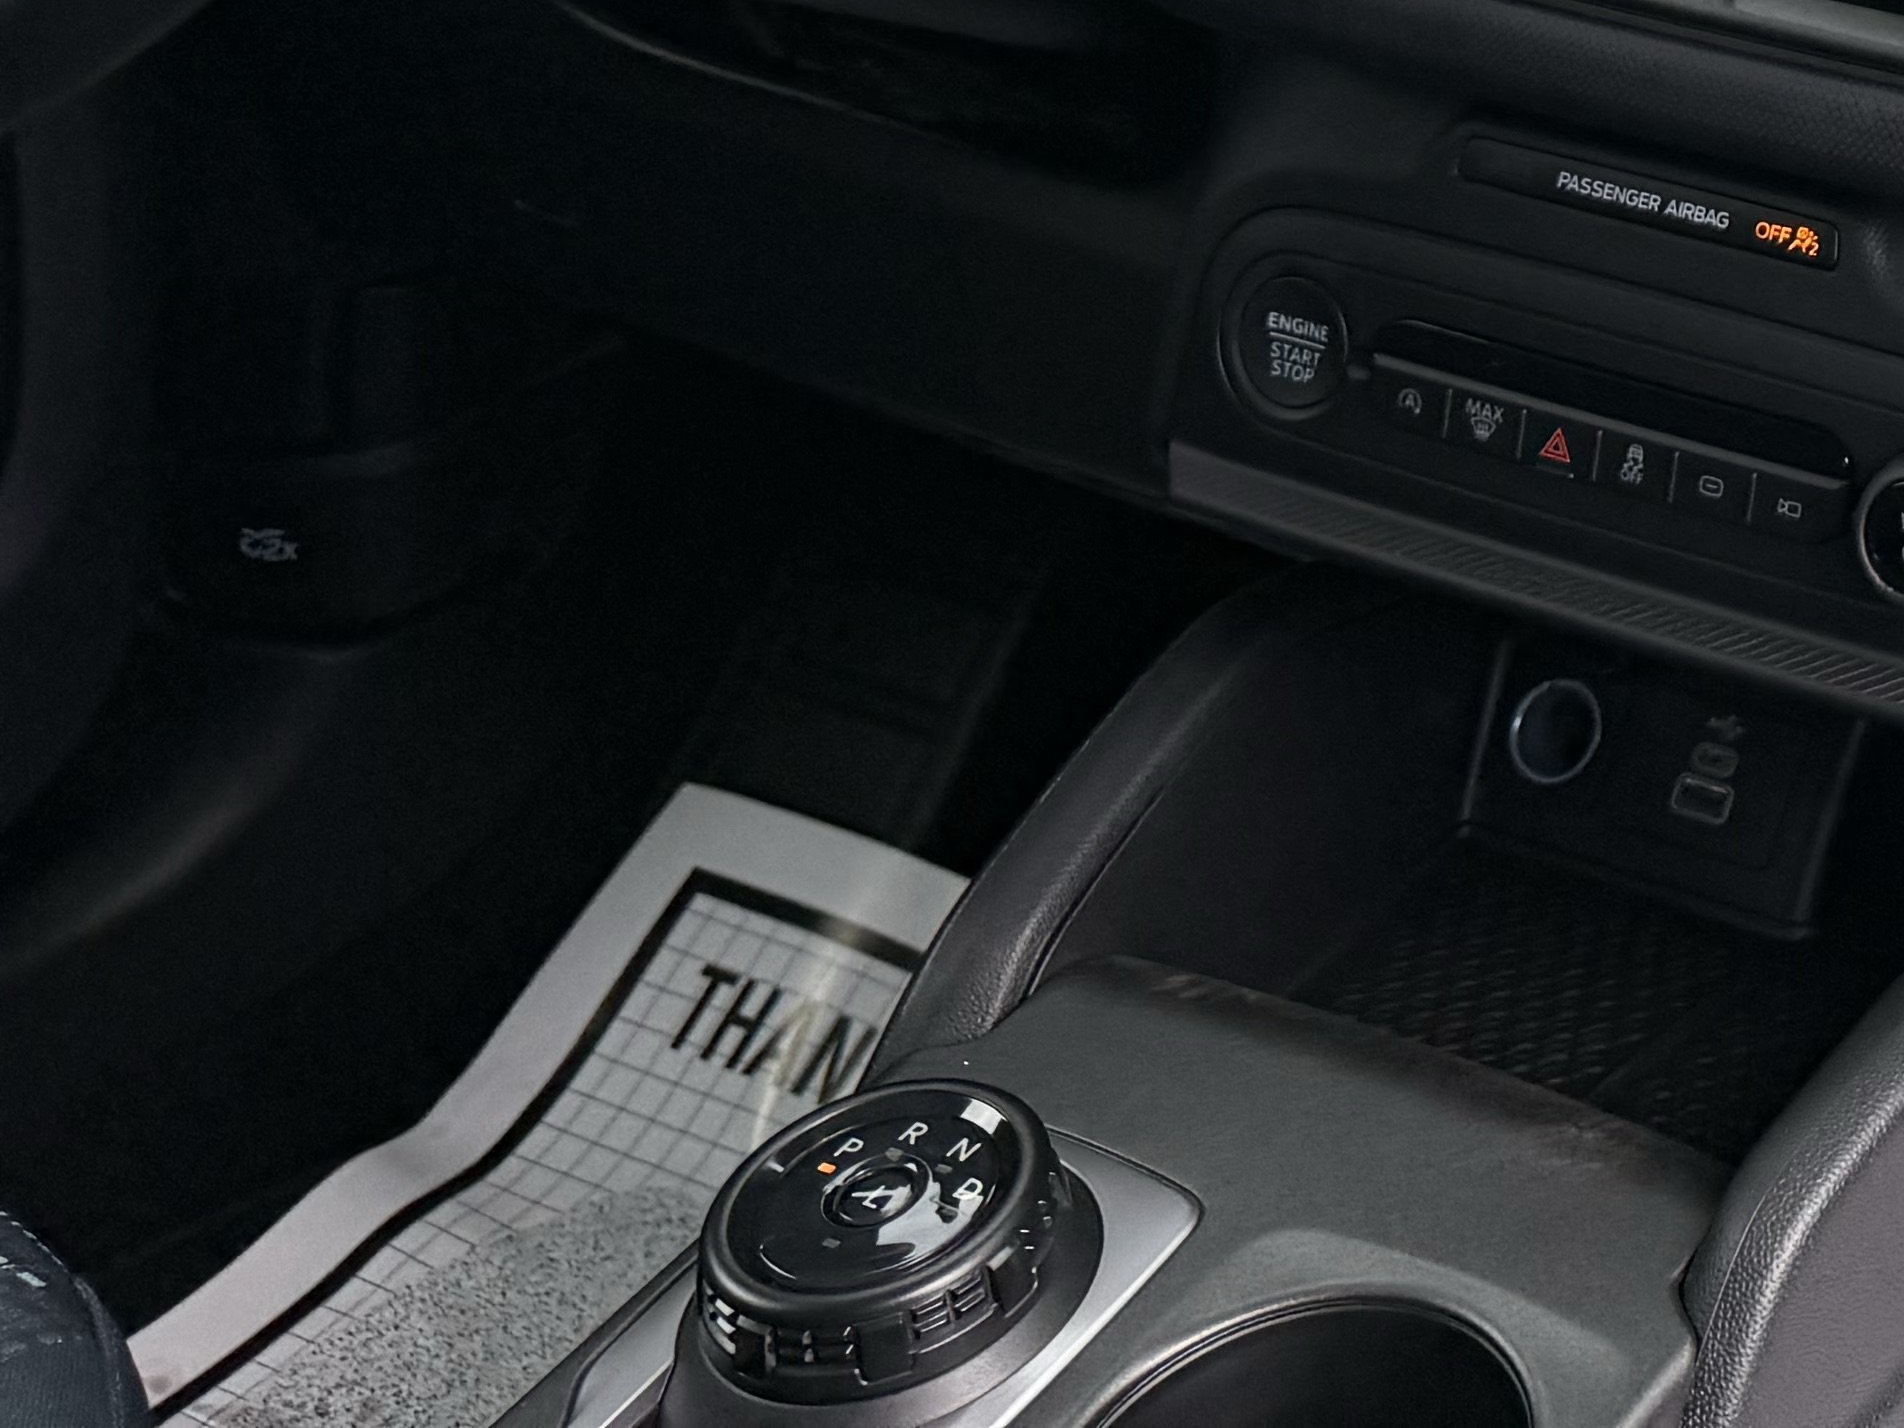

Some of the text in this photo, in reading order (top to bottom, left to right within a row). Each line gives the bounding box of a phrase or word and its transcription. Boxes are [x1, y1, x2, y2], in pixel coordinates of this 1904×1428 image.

[1557, 171, 1792, 243] PASSENGER AIRBAG OFF
[1266, 312, 1328, 342] ENGINE
[1270, 342, 1321, 366] START
[1270, 360, 1315, 383] STOP
[1465, 398, 1504, 423] MAX
[898, 1121, 929, 1145] R
[834, 1137, 864, 1157] P
[946, 1138, 982, 1162] N
[953, 1177, 983, 1200] D
